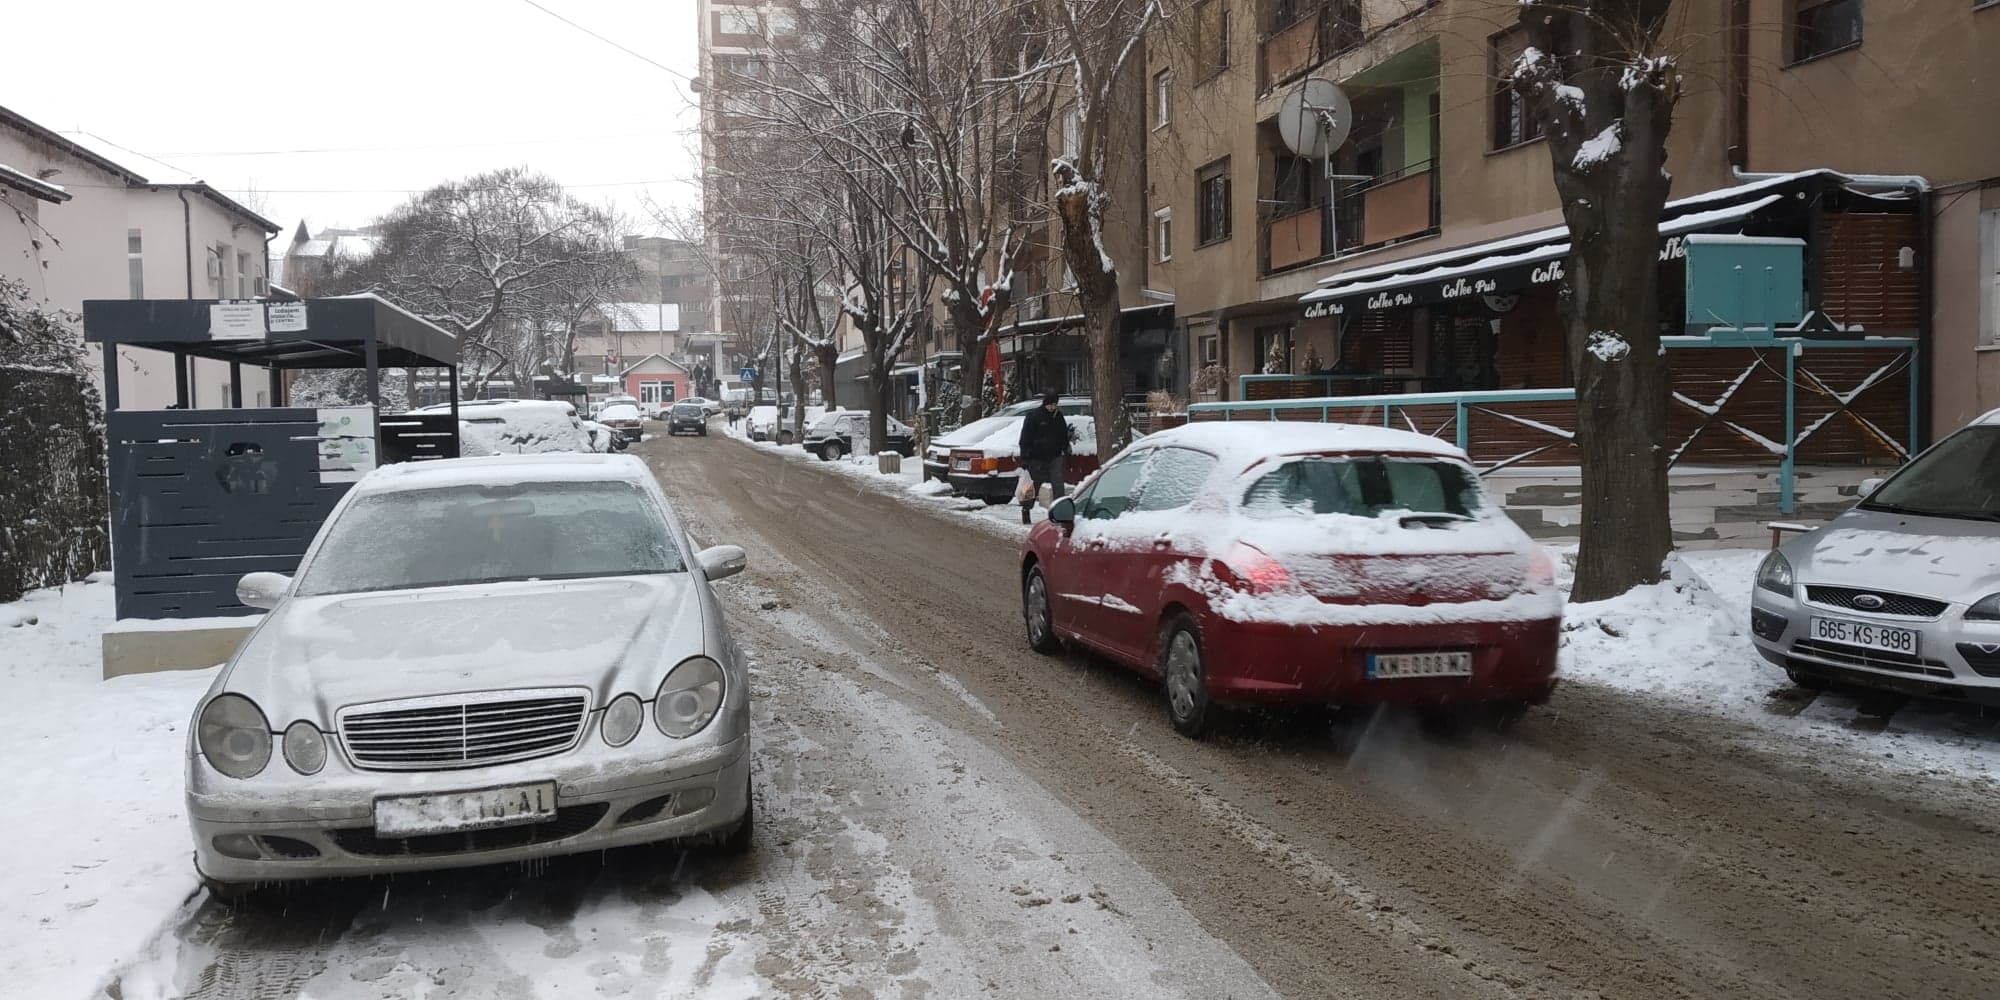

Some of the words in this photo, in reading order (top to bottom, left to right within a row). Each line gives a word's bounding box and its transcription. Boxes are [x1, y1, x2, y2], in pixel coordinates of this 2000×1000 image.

[1658, 237, 1687, 261] ffe
[1531, 260, 1566, 283] Coffe
[1442, 278, 1473, 299] Coffee
[1475, 279, 1497, 294] Pub
[1304, 302, 1327, 318] Coffee
[1329, 304, 1344, 315] Pub
[1367, 292, 1393, 310] Coffee
[1395, 293, 1413, 306] Pub
[1819, 620, 1911, 651] 665-KS-898
